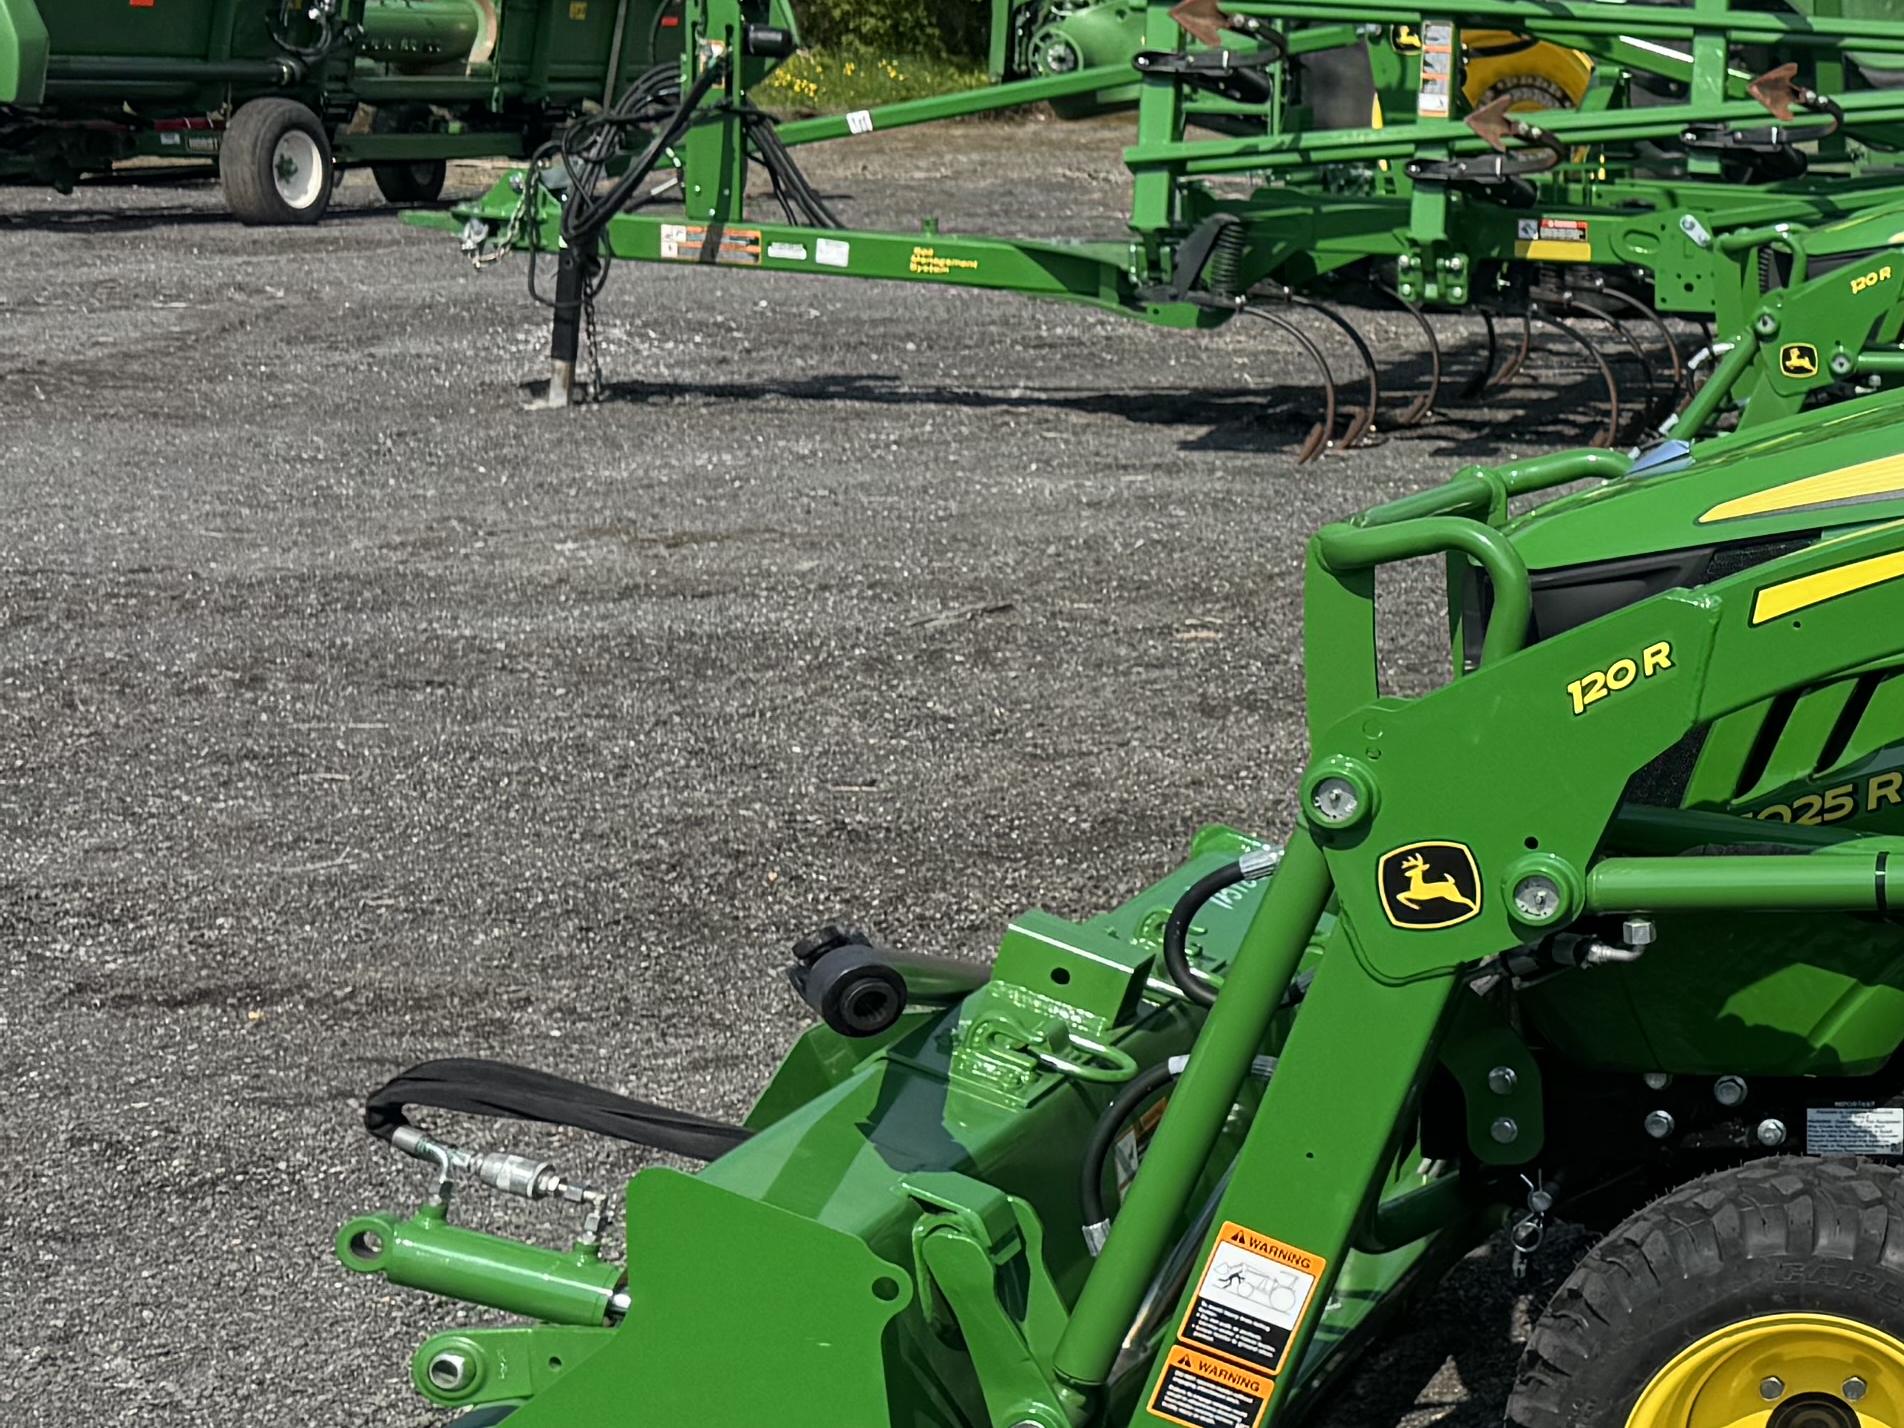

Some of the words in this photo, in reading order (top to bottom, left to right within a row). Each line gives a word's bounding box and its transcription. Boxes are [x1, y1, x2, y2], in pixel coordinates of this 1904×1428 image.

[1850, 272, 1879, 294] 120
[1880, 266, 1891, 281] R
[1567, 658, 1637, 715] 120
[1643, 641, 1672, 676] R
[1867, 772, 1903, 811] R
[1249, 1236, 1311, 1269] WARNING
[1199, 1361, 1261, 1392] WARNING
